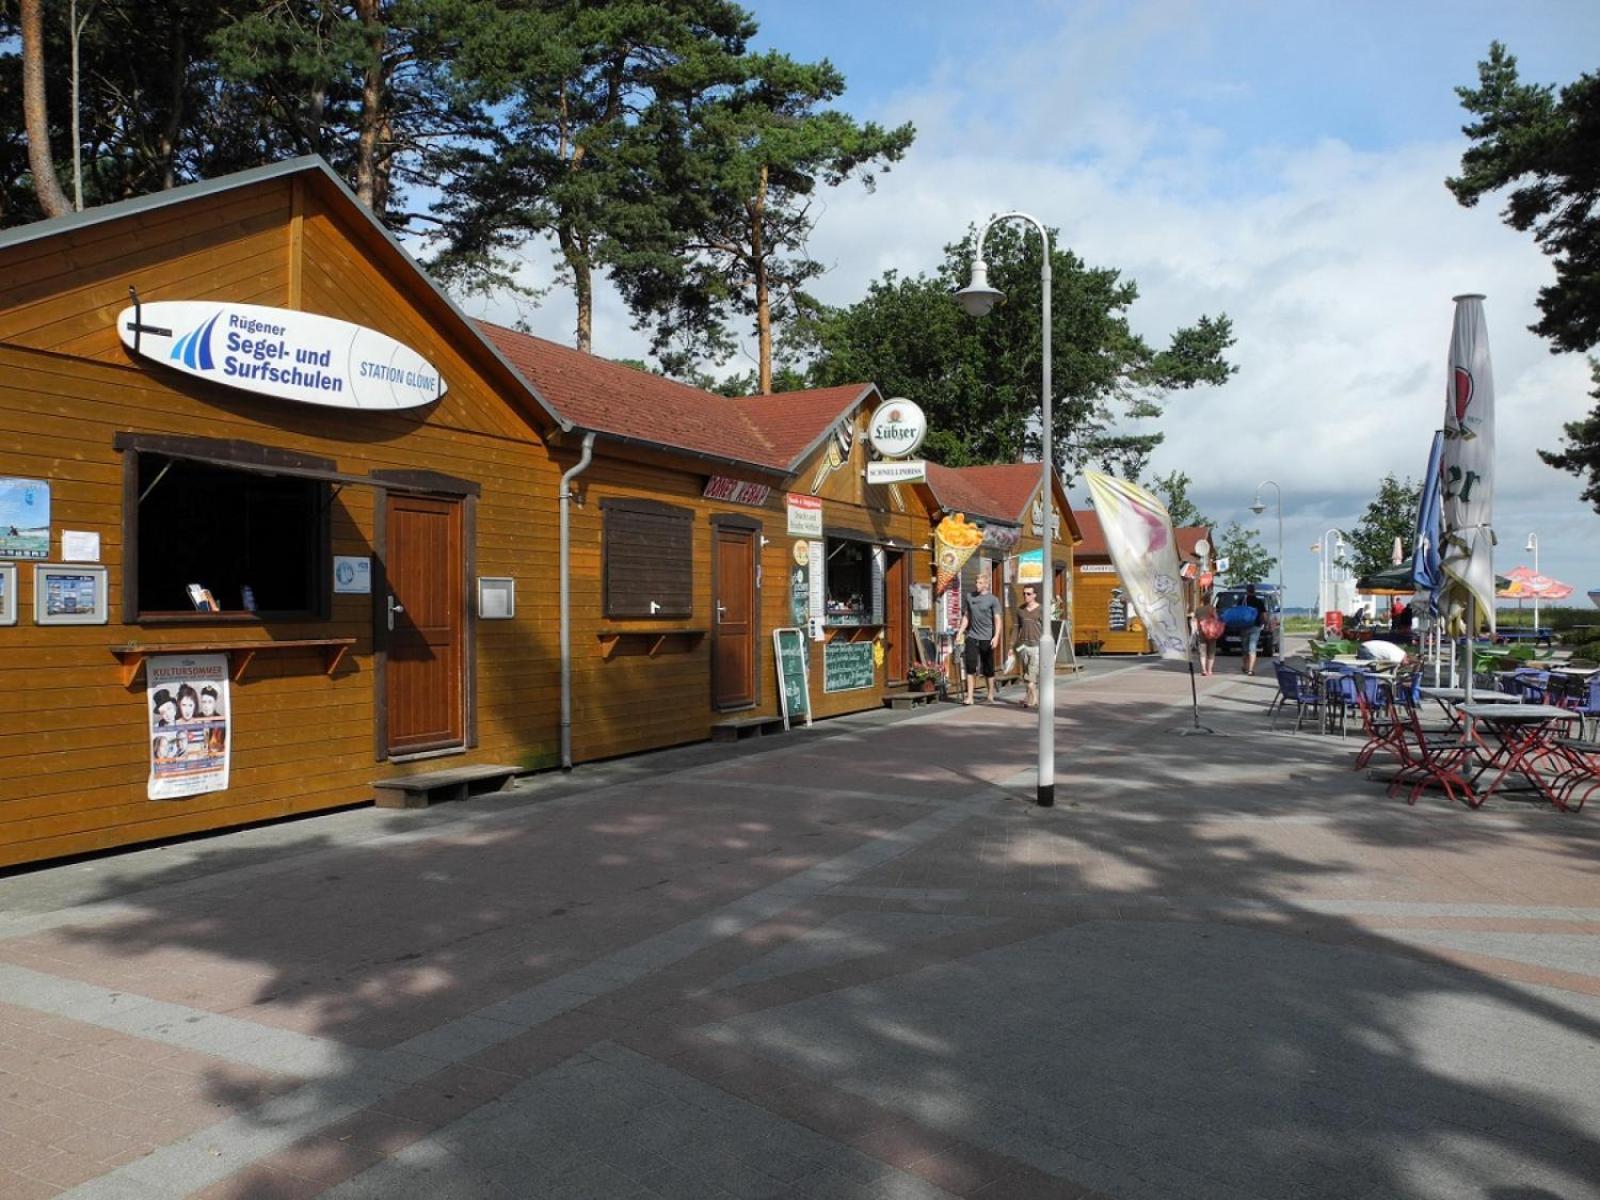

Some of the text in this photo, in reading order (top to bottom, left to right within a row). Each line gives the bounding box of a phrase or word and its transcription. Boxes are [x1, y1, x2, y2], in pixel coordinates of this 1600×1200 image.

[229, 314, 286, 336] Rügener
[227, 332, 331, 367] Segel- und
[224, 356, 343, 392] Surfschulen
[360, 361, 404, 385] STATION
[874, 424, 917, 441] Lübzer
[153, 667, 222, 676] KULTURSOMMER
